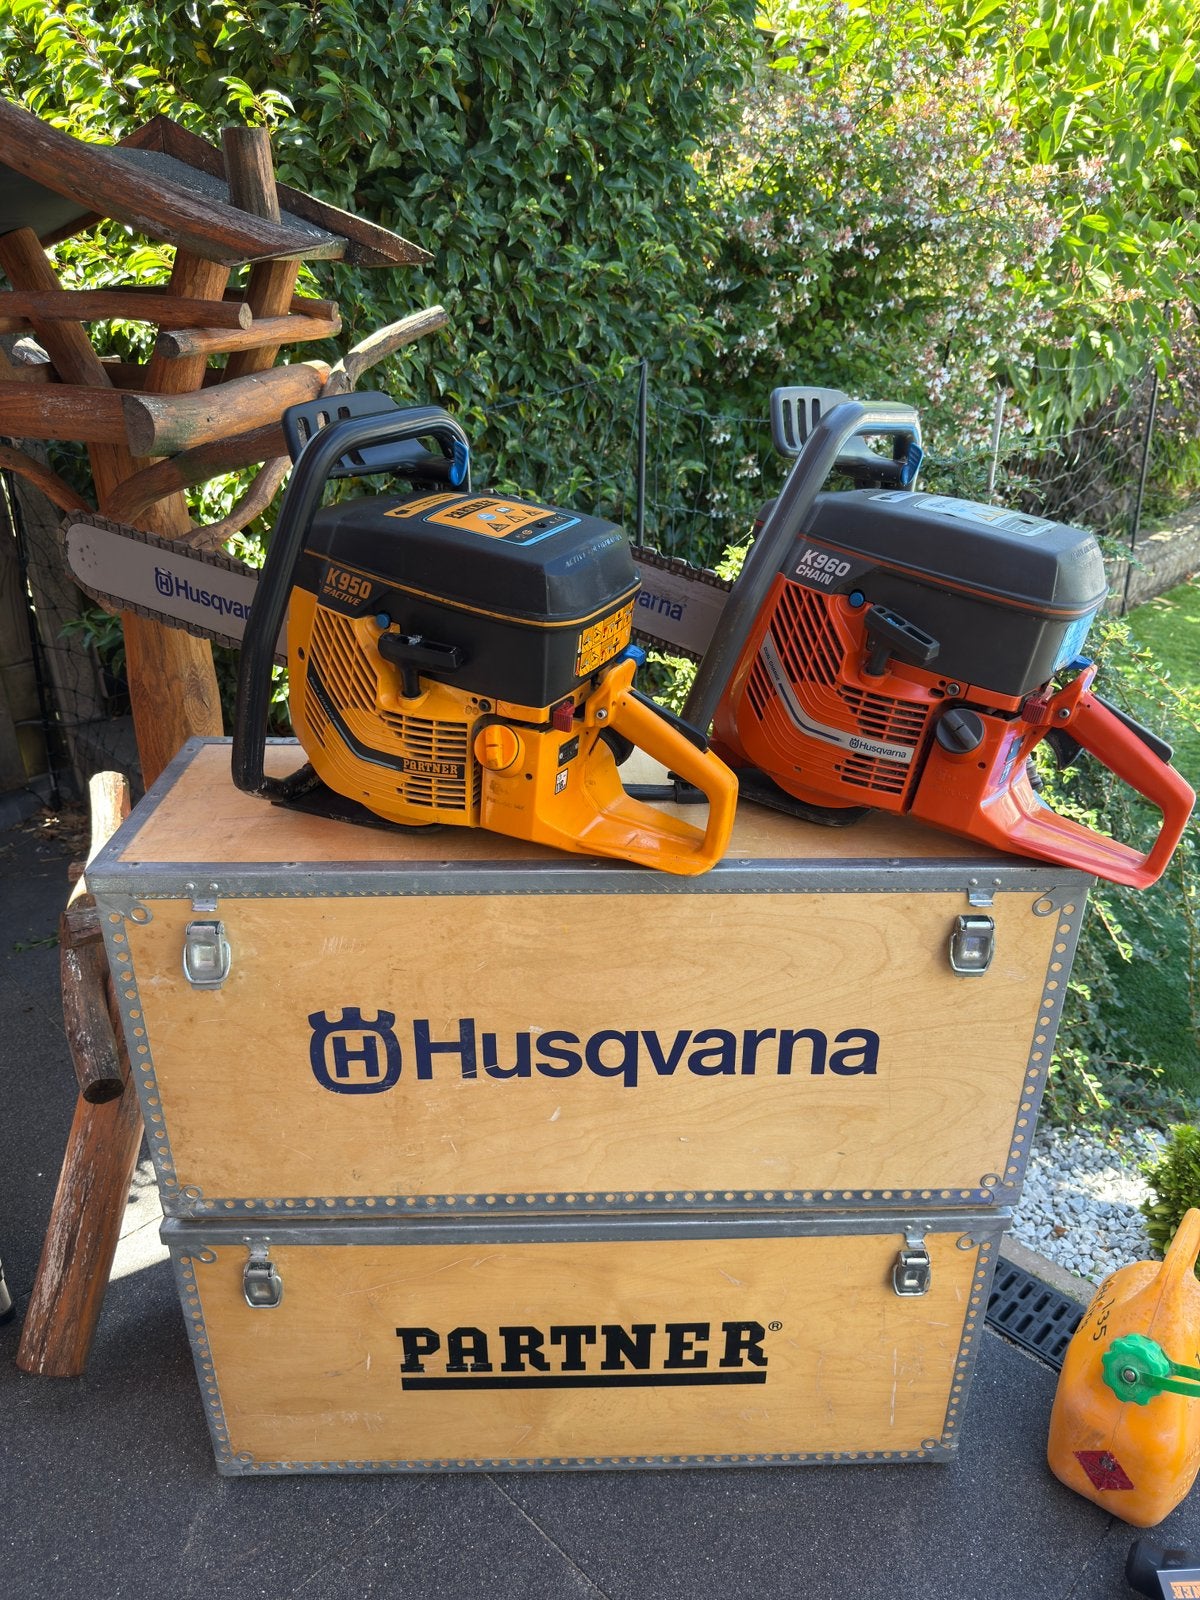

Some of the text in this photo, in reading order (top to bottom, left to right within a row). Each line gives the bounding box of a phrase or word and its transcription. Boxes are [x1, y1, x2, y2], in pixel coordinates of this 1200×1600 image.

[795, 564, 834, 585] CHAIN
[800, 549, 851, 577] K960
[326, 567, 372, 599] K950
[175, 577, 252, 620] Husqvar
[329, 589, 362, 607] ACTIVE
[859, 741, 907, 759] Husqvarna
[403, 758, 458, 775] PARTNER
[413, 1017, 881, 1088] Husqvarna
[396, 1321, 768, 1373] PARTNER
